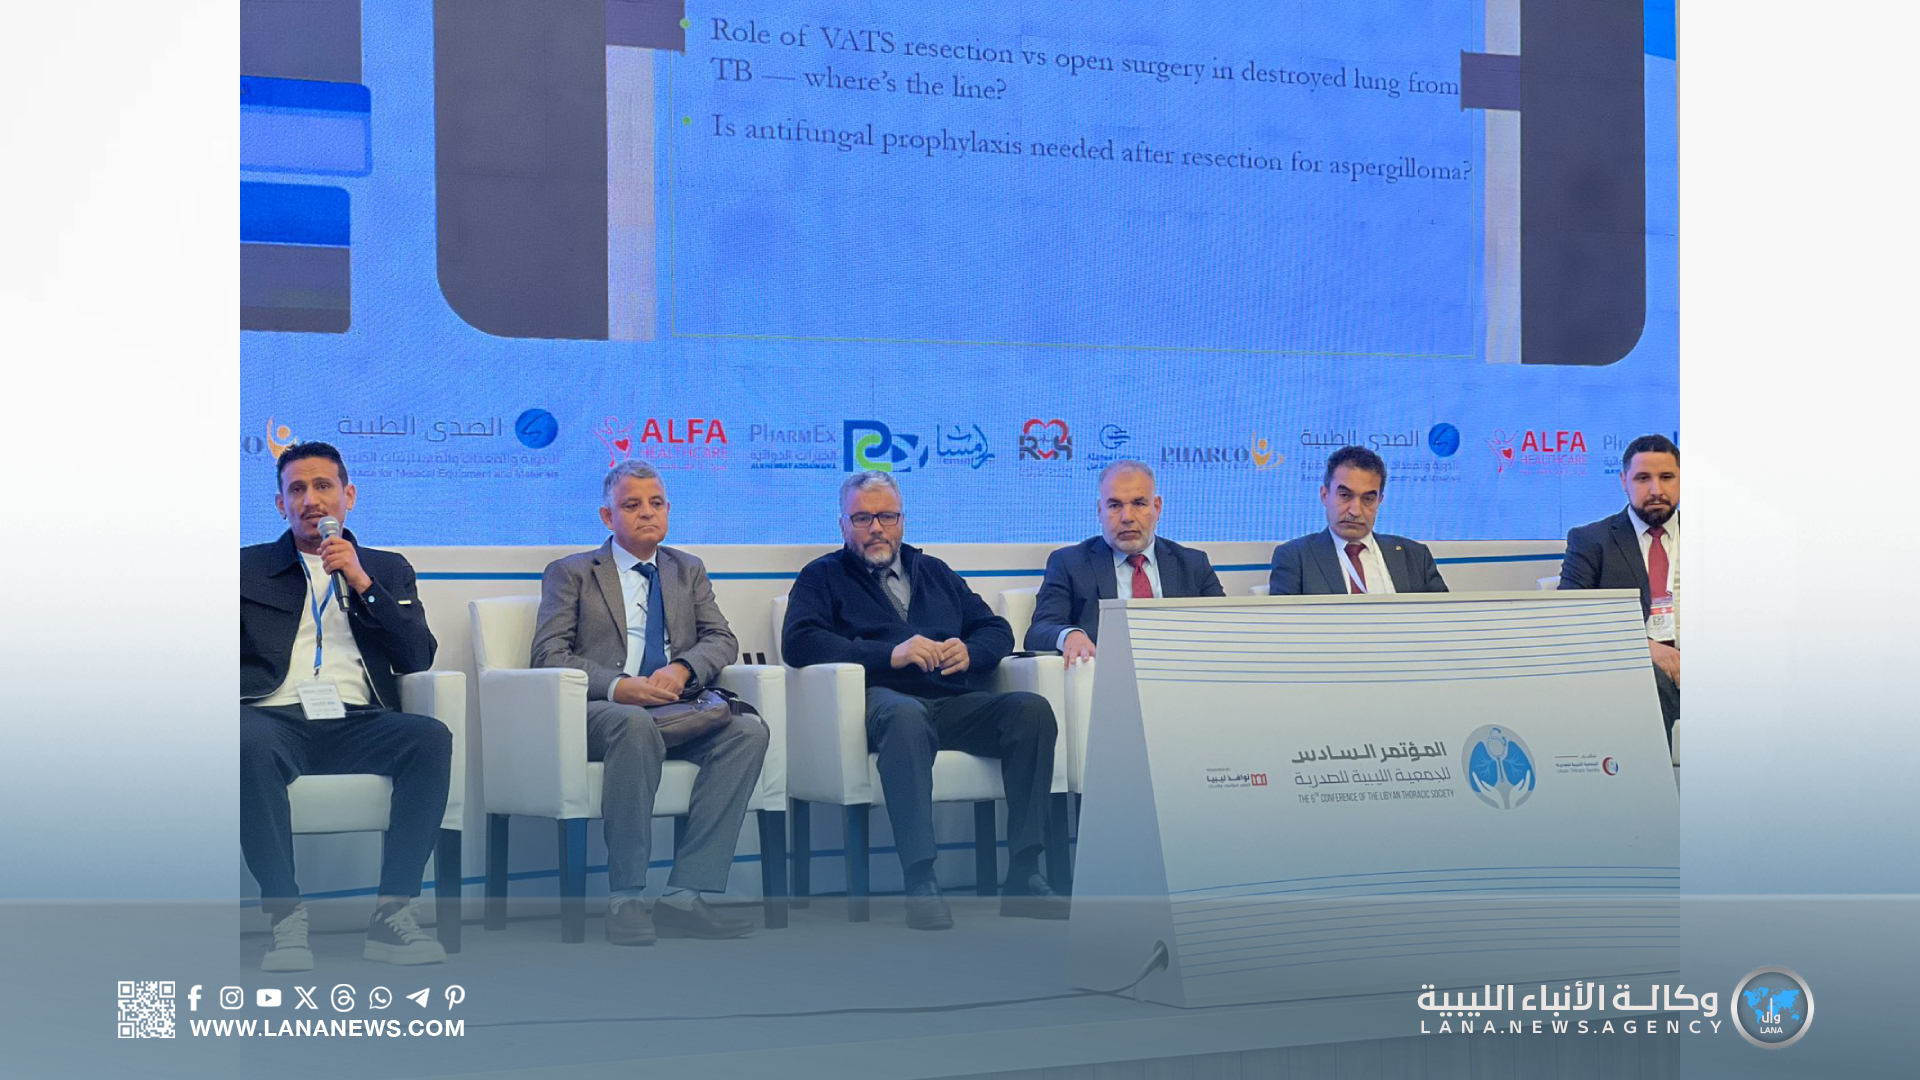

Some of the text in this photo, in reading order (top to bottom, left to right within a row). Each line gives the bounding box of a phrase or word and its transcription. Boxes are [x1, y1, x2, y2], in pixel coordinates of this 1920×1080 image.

[711, 18, 1460, 97] Role of VATS resection vs open surgery in destroyed lung from
[710, 57, 753, 82] TB
[905, 73, 944, 96] the
[952, 74, 1007, 99] line?
[711, 115, 1473, 183] Is antifungal prophylaxis needed after resection for aspergilloma?
[338, 415, 502, 442] الصدى الطبية
[640, 418, 727, 443] ALFA
[640, 446, 728, 459] HEALTHCARE
[1521, 431, 1587, 452] ALFA
[1160, 446, 1249, 462] PHARCO
[1521, 454, 1588, 465] HEALTHCARE
[1291, 741, 1448, 764] المؤتمر السادس
[1294, 767, 1452, 788] للجمعية الليبية للصدرية
[1298, 794, 1310, 803] THE
[1321, 792, 1358, 803] CONFERENCE
[1359, 792, 1367, 801] OF
[1368, 791, 1379, 801] THE
[1379, 790, 1401, 800] LIBYAN
[1401, 789, 1429, 800] THORACIC
[1431, 788, 1454, 799] SOCIETY
